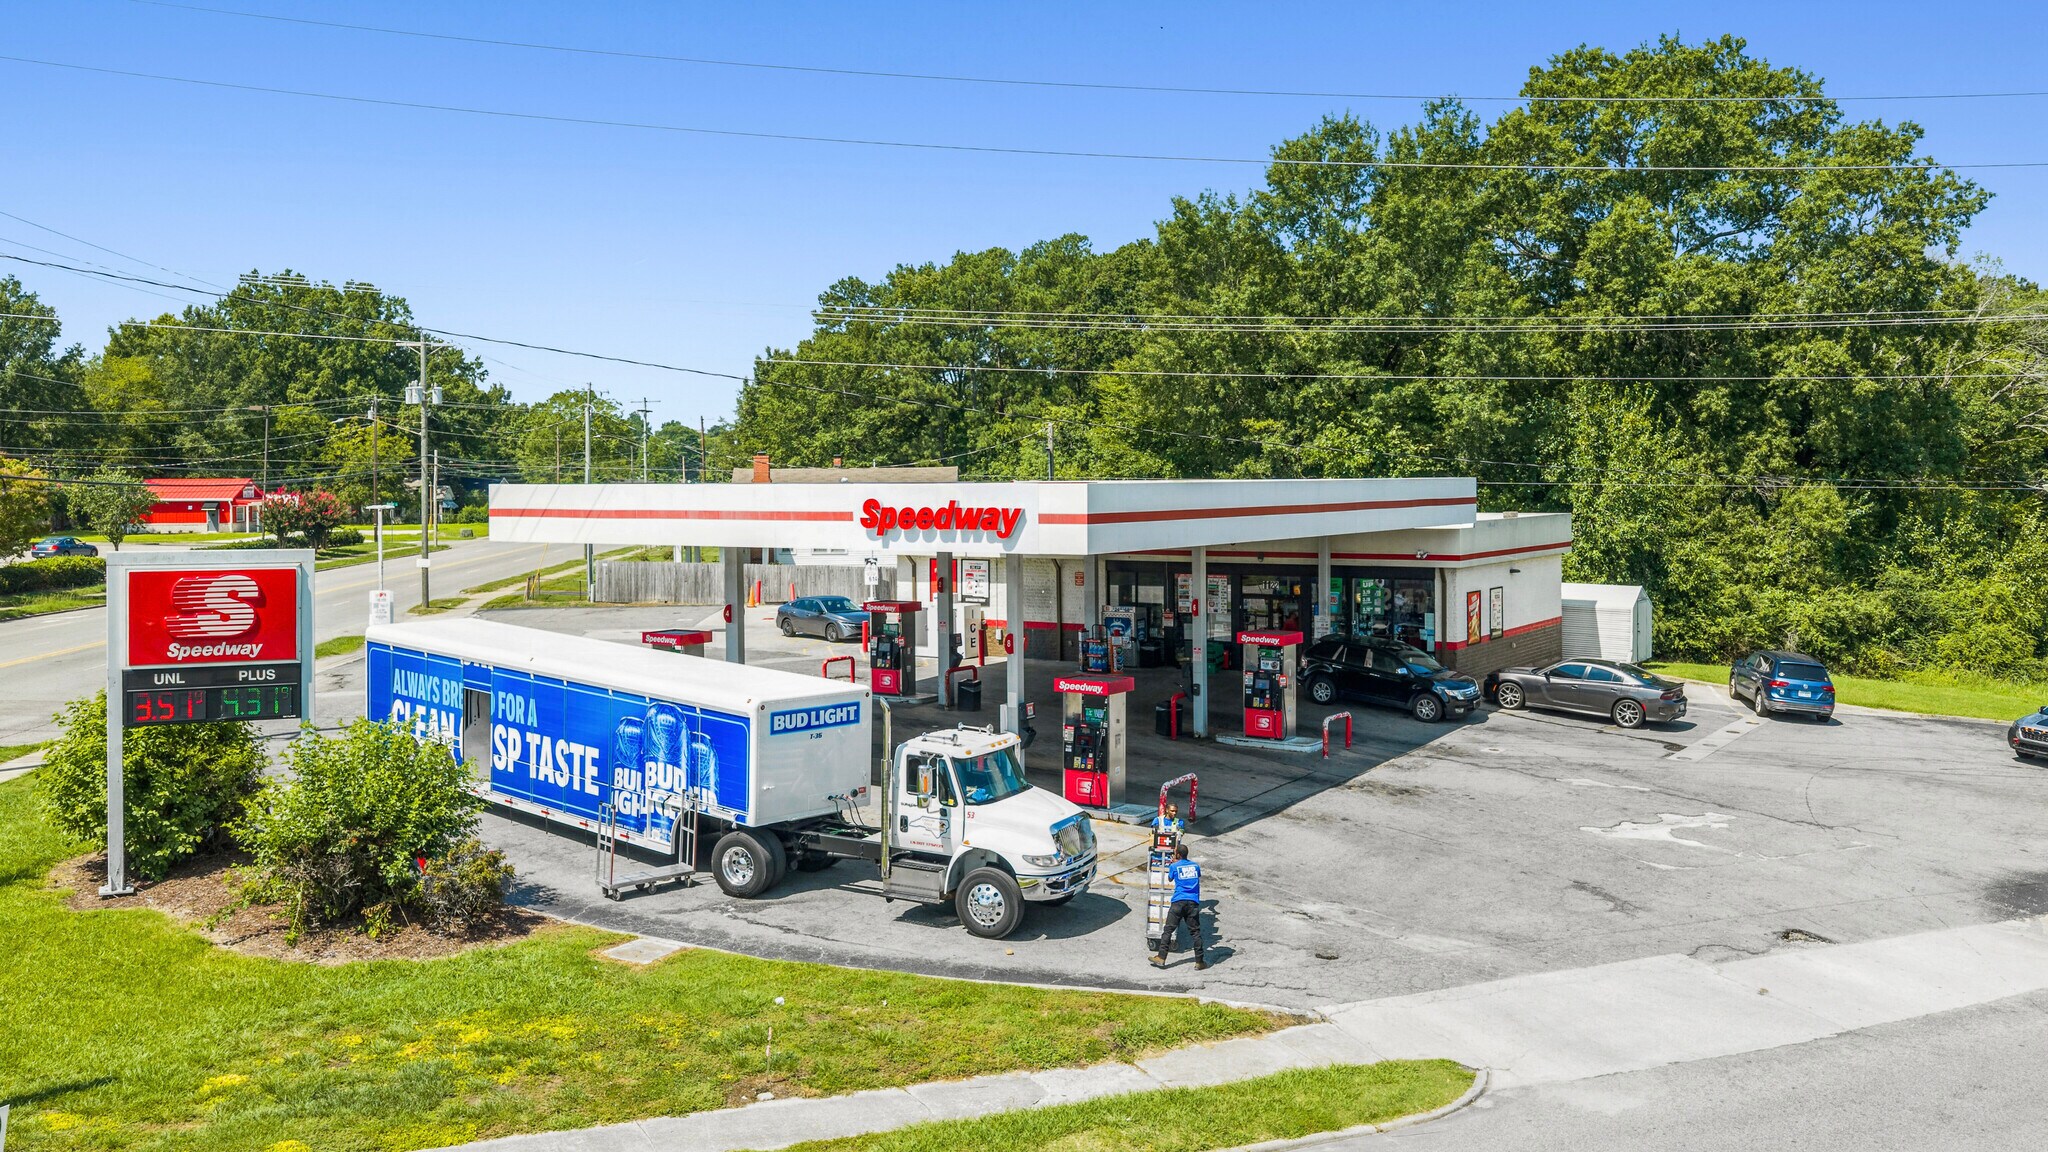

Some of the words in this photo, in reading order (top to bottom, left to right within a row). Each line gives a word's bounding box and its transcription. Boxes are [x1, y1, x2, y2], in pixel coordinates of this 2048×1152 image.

[860, 498, 1023, 539] Speedway
[1262, 580, 1280, 590] 1122
[866, 602, 897, 613] Speedway
[645, 633, 678, 646] Speedway
[1240, 634, 1280, 646] Speedway
[166, 641, 264, 661] Speedway
[153, 672, 186, 685] UNL
[238, 668, 277, 682] PLUS
[1058, 680, 1104, 694] Speedway
[393, 668, 441, 704] ALWAYS
[498, 690, 525, 725] FOR
[527, 697, 538, 728] A
[773, 711, 809, 732] BUD
[810, 705, 857, 728] LIGHT
[526, 731, 600, 797] TASTE
[645, 760, 687, 793] BUD
[966, 811, 975, 819] 53
